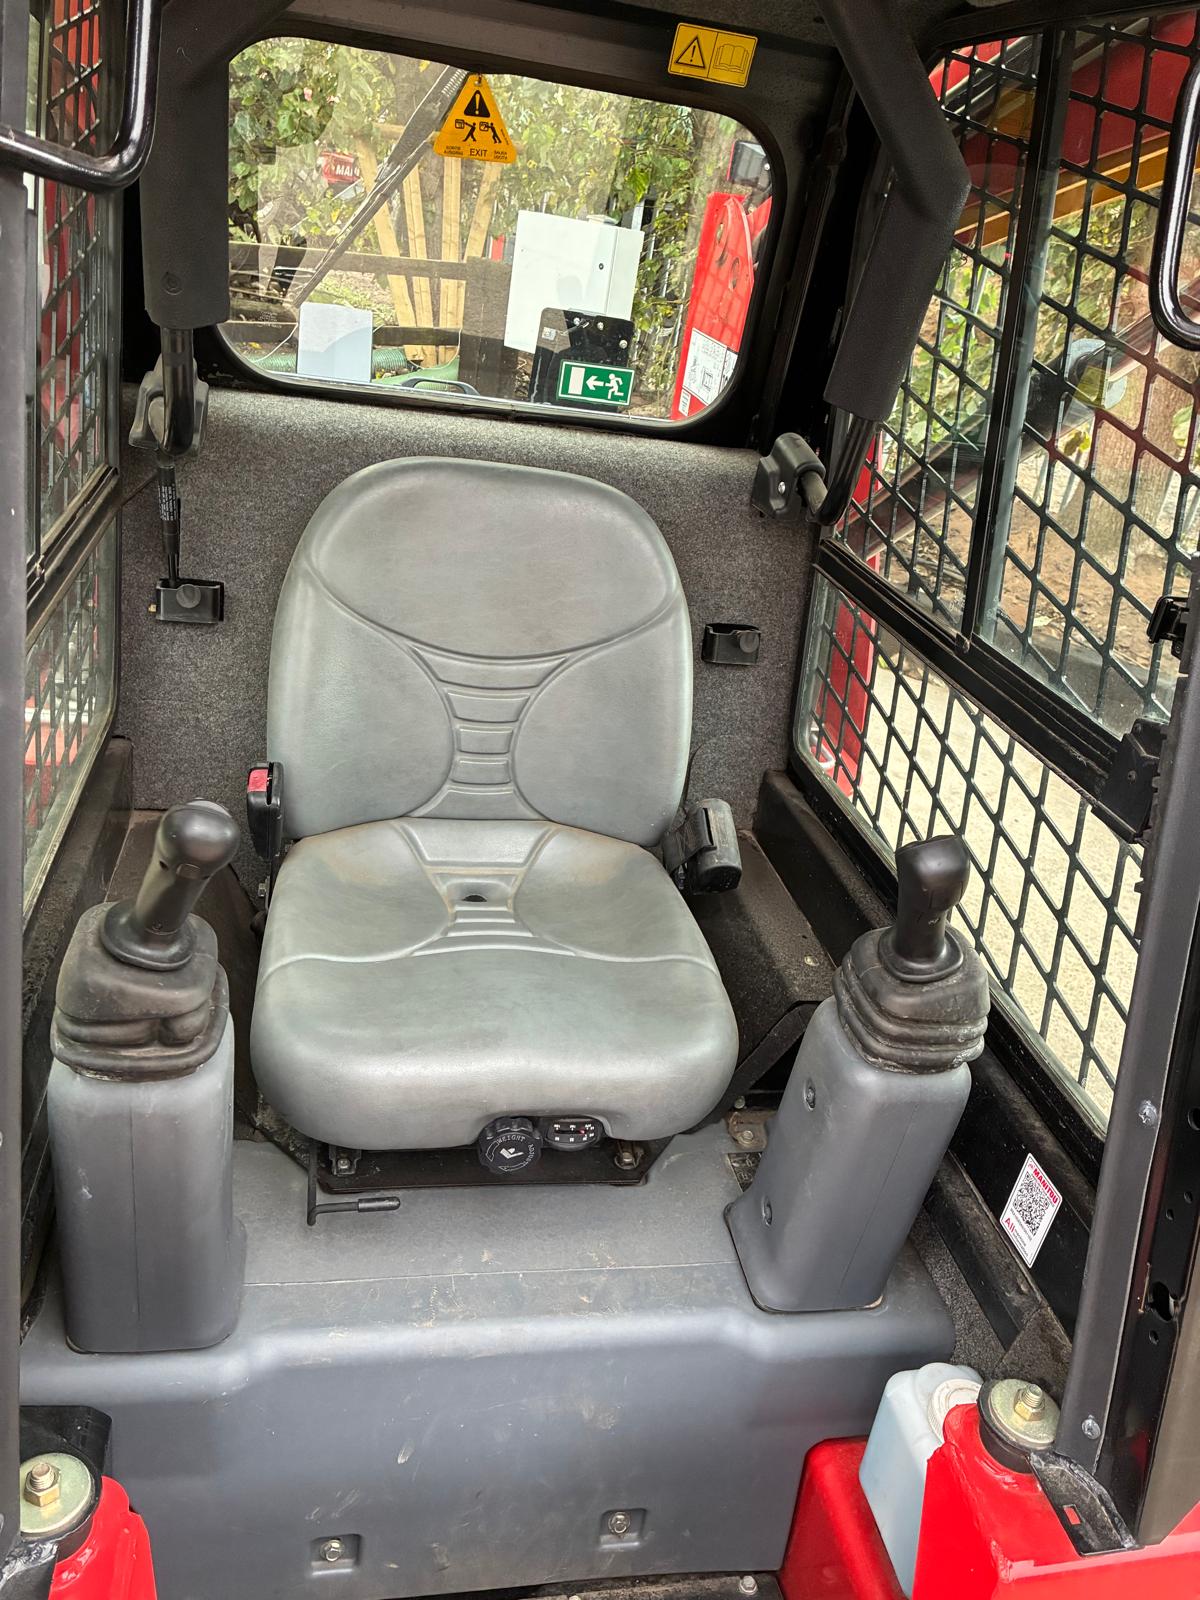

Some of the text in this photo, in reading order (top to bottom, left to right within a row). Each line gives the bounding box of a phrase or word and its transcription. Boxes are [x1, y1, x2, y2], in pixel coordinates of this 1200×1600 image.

[470, 148, 487, 157] EXIT
[496, 1134, 526, 1143] WEIGHT
[1033, 1169, 1058, 1204] MANITOU
[1005, 1217, 1015, 1232] All
